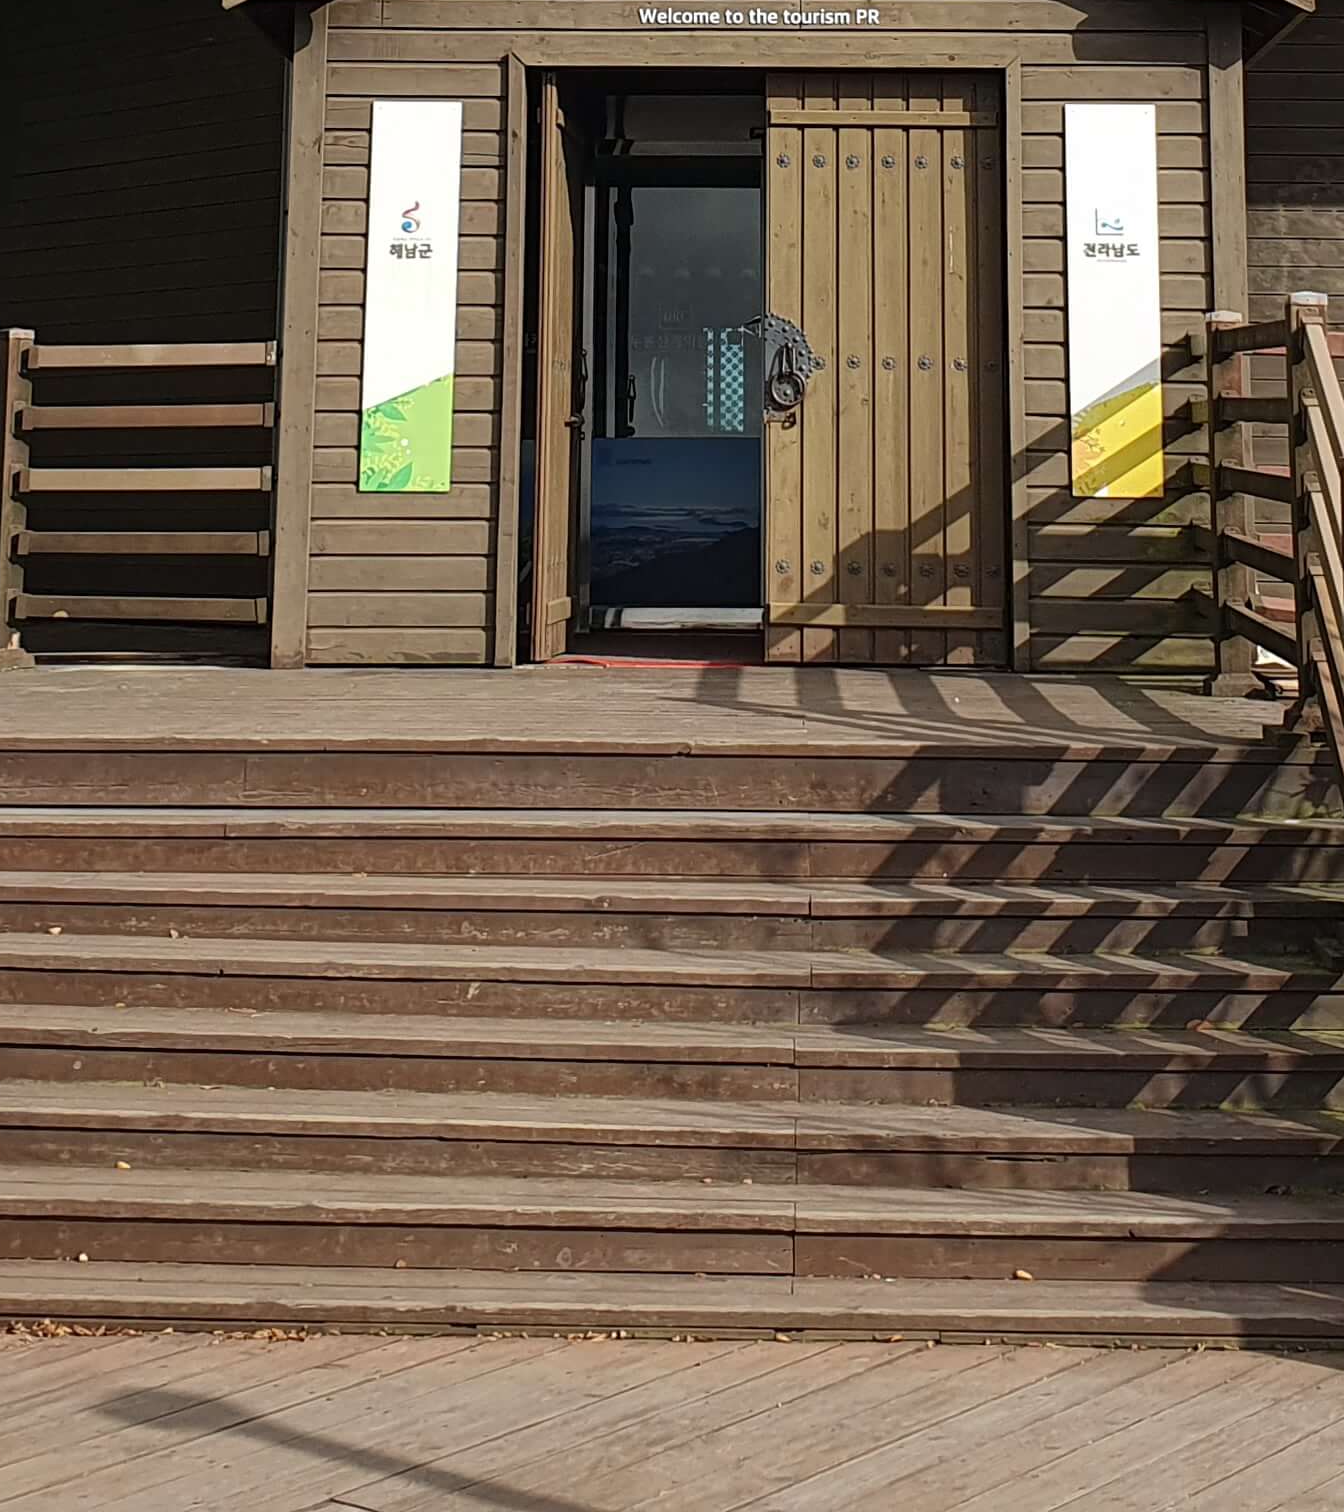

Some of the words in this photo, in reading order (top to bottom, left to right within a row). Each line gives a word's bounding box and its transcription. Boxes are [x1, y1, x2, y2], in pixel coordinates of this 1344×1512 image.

[639, 7, 721, 25] Welcome
[725, 9, 744, 25] to
[749, 7, 778, 25] the
[783, 8, 851, 25] tourism
[856, 9, 880, 25] PR
[389, 243, 433, 260] 해남군
[1083, 242, 1141, 258] 전라남도
